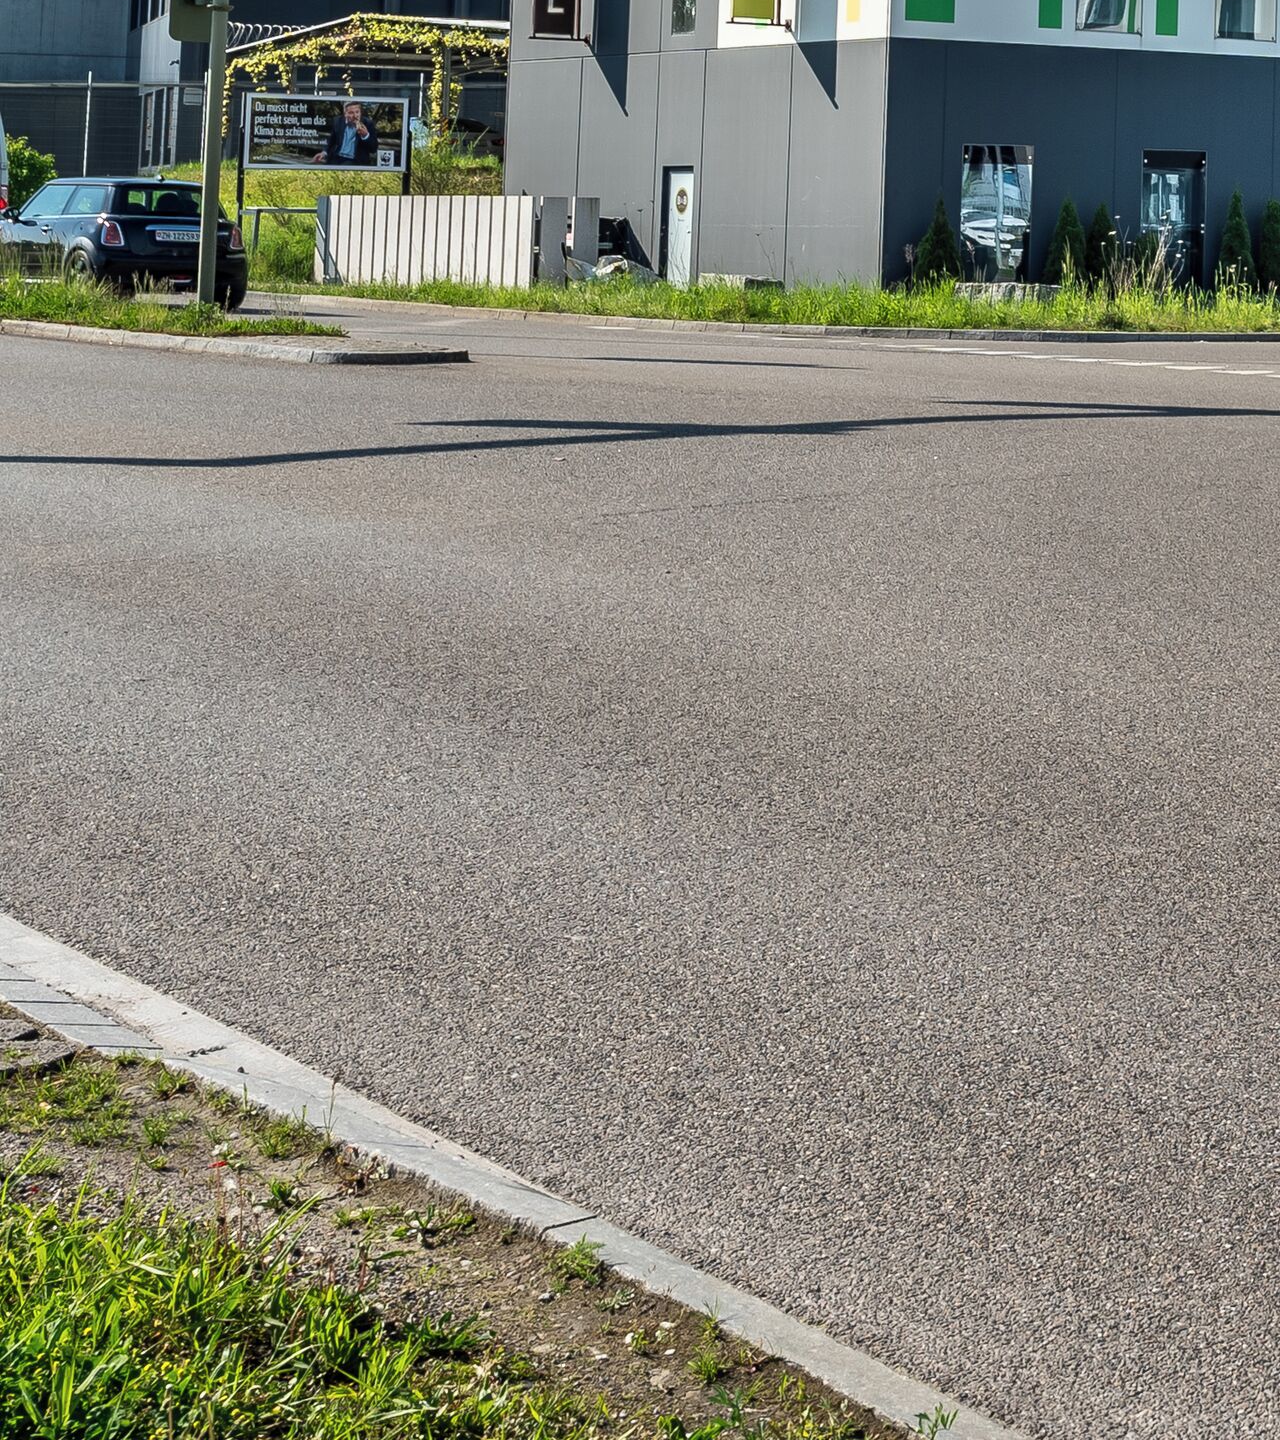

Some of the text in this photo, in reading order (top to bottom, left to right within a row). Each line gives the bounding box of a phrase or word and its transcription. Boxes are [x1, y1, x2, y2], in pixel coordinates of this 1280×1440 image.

[255, 101, 308, 113] Du musst nicht
[254, 114, 327, 126] perfekt sein, um das
[254, 125, 274, 136] Klima
[275, 128, 284, 136] zu
